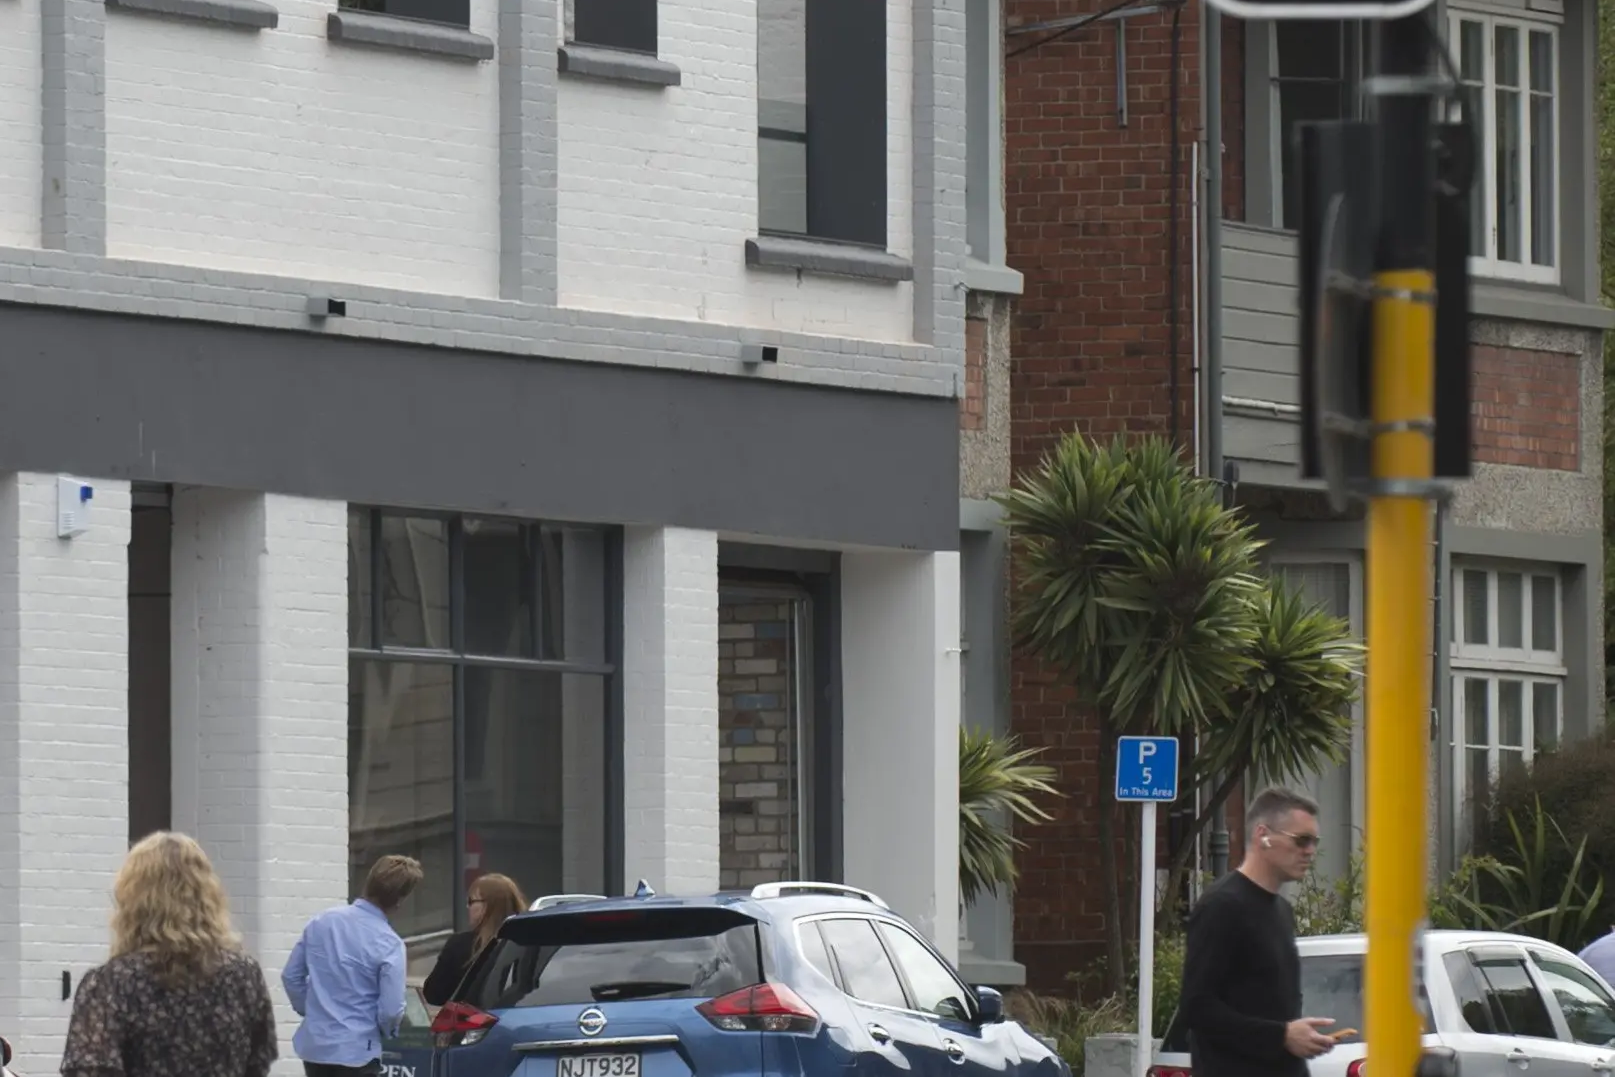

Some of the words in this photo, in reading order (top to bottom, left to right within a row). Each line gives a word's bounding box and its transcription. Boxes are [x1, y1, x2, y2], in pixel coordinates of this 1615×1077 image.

[1139, 741, 1157, 764] P
[1142, 767, 1152, 785] 5
[1119, 787, 1128, 796] In
[1131, 787, 1149, 796] This
[1152, 787, 1173, 797] Area
[561, 1056, 636, 1077] NJT932
